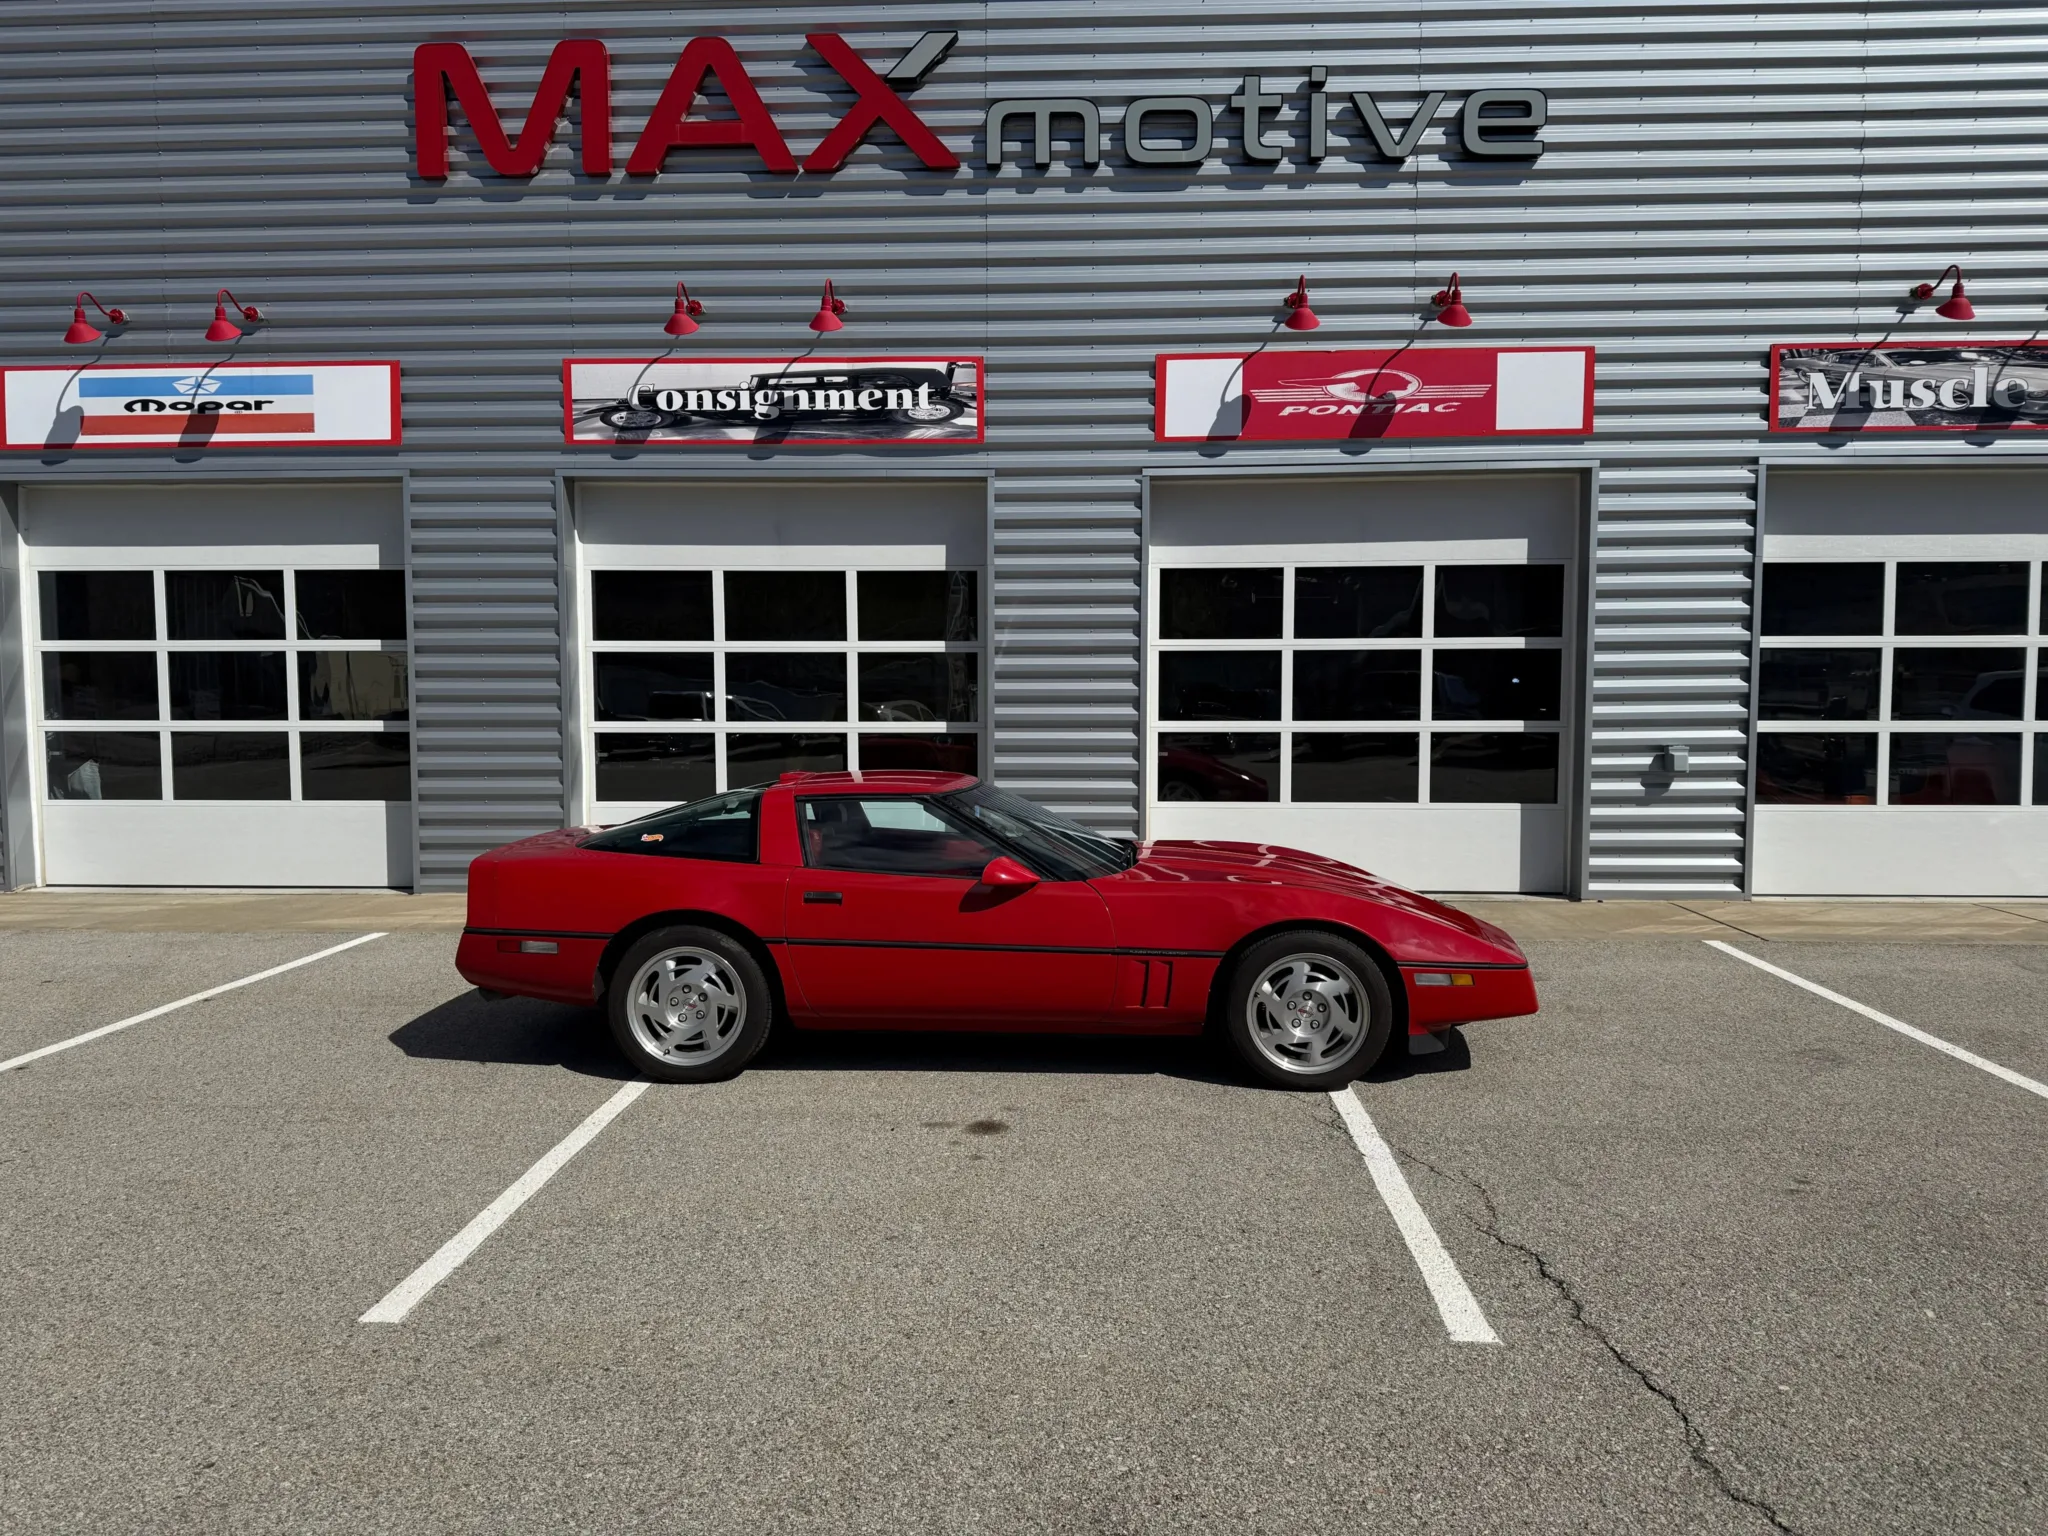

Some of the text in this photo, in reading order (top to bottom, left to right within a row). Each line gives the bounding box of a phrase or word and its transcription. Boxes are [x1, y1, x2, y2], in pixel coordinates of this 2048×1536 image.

[414, 30, 1548, 180] MAX motive
[627, 381, 937, 420] Consignment
[1278, 402, 1462, 416] PONTIAC
[1804, 365, 2030, 411] Muscle
